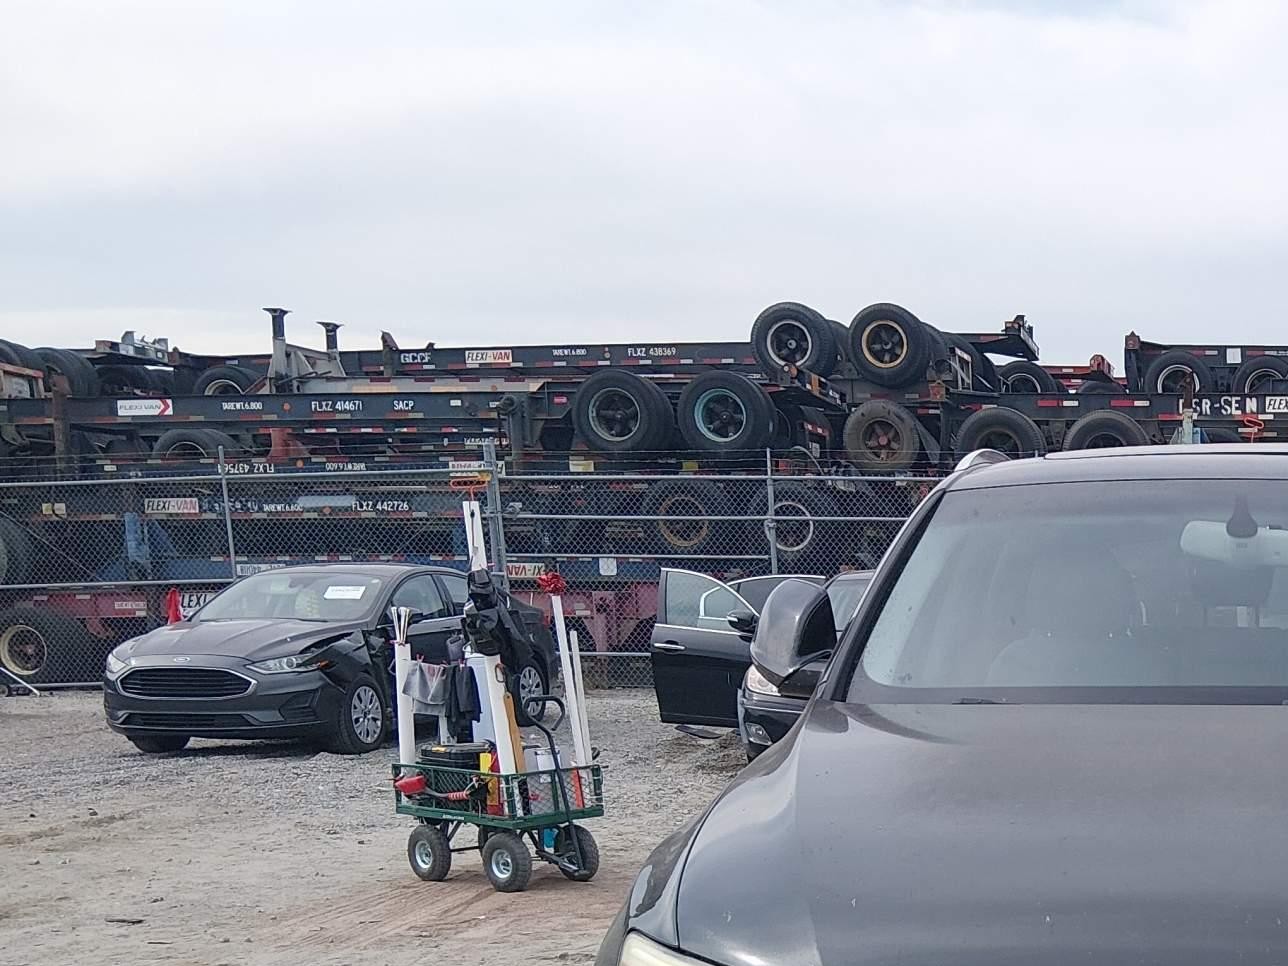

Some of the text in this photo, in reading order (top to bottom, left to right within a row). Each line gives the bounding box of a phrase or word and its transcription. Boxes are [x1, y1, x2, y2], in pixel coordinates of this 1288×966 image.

[466, 351, 511, 362] FLEXI-VAN
[628, 347, 677, 357] FLXZ 438369
[311, 400, 362, 412] FLXZ 414671
[393, 400, 415, 411] SACP
[145, 499, 198, 513] FLEXI-VAN
[376, 500, 409, 511] 442726
